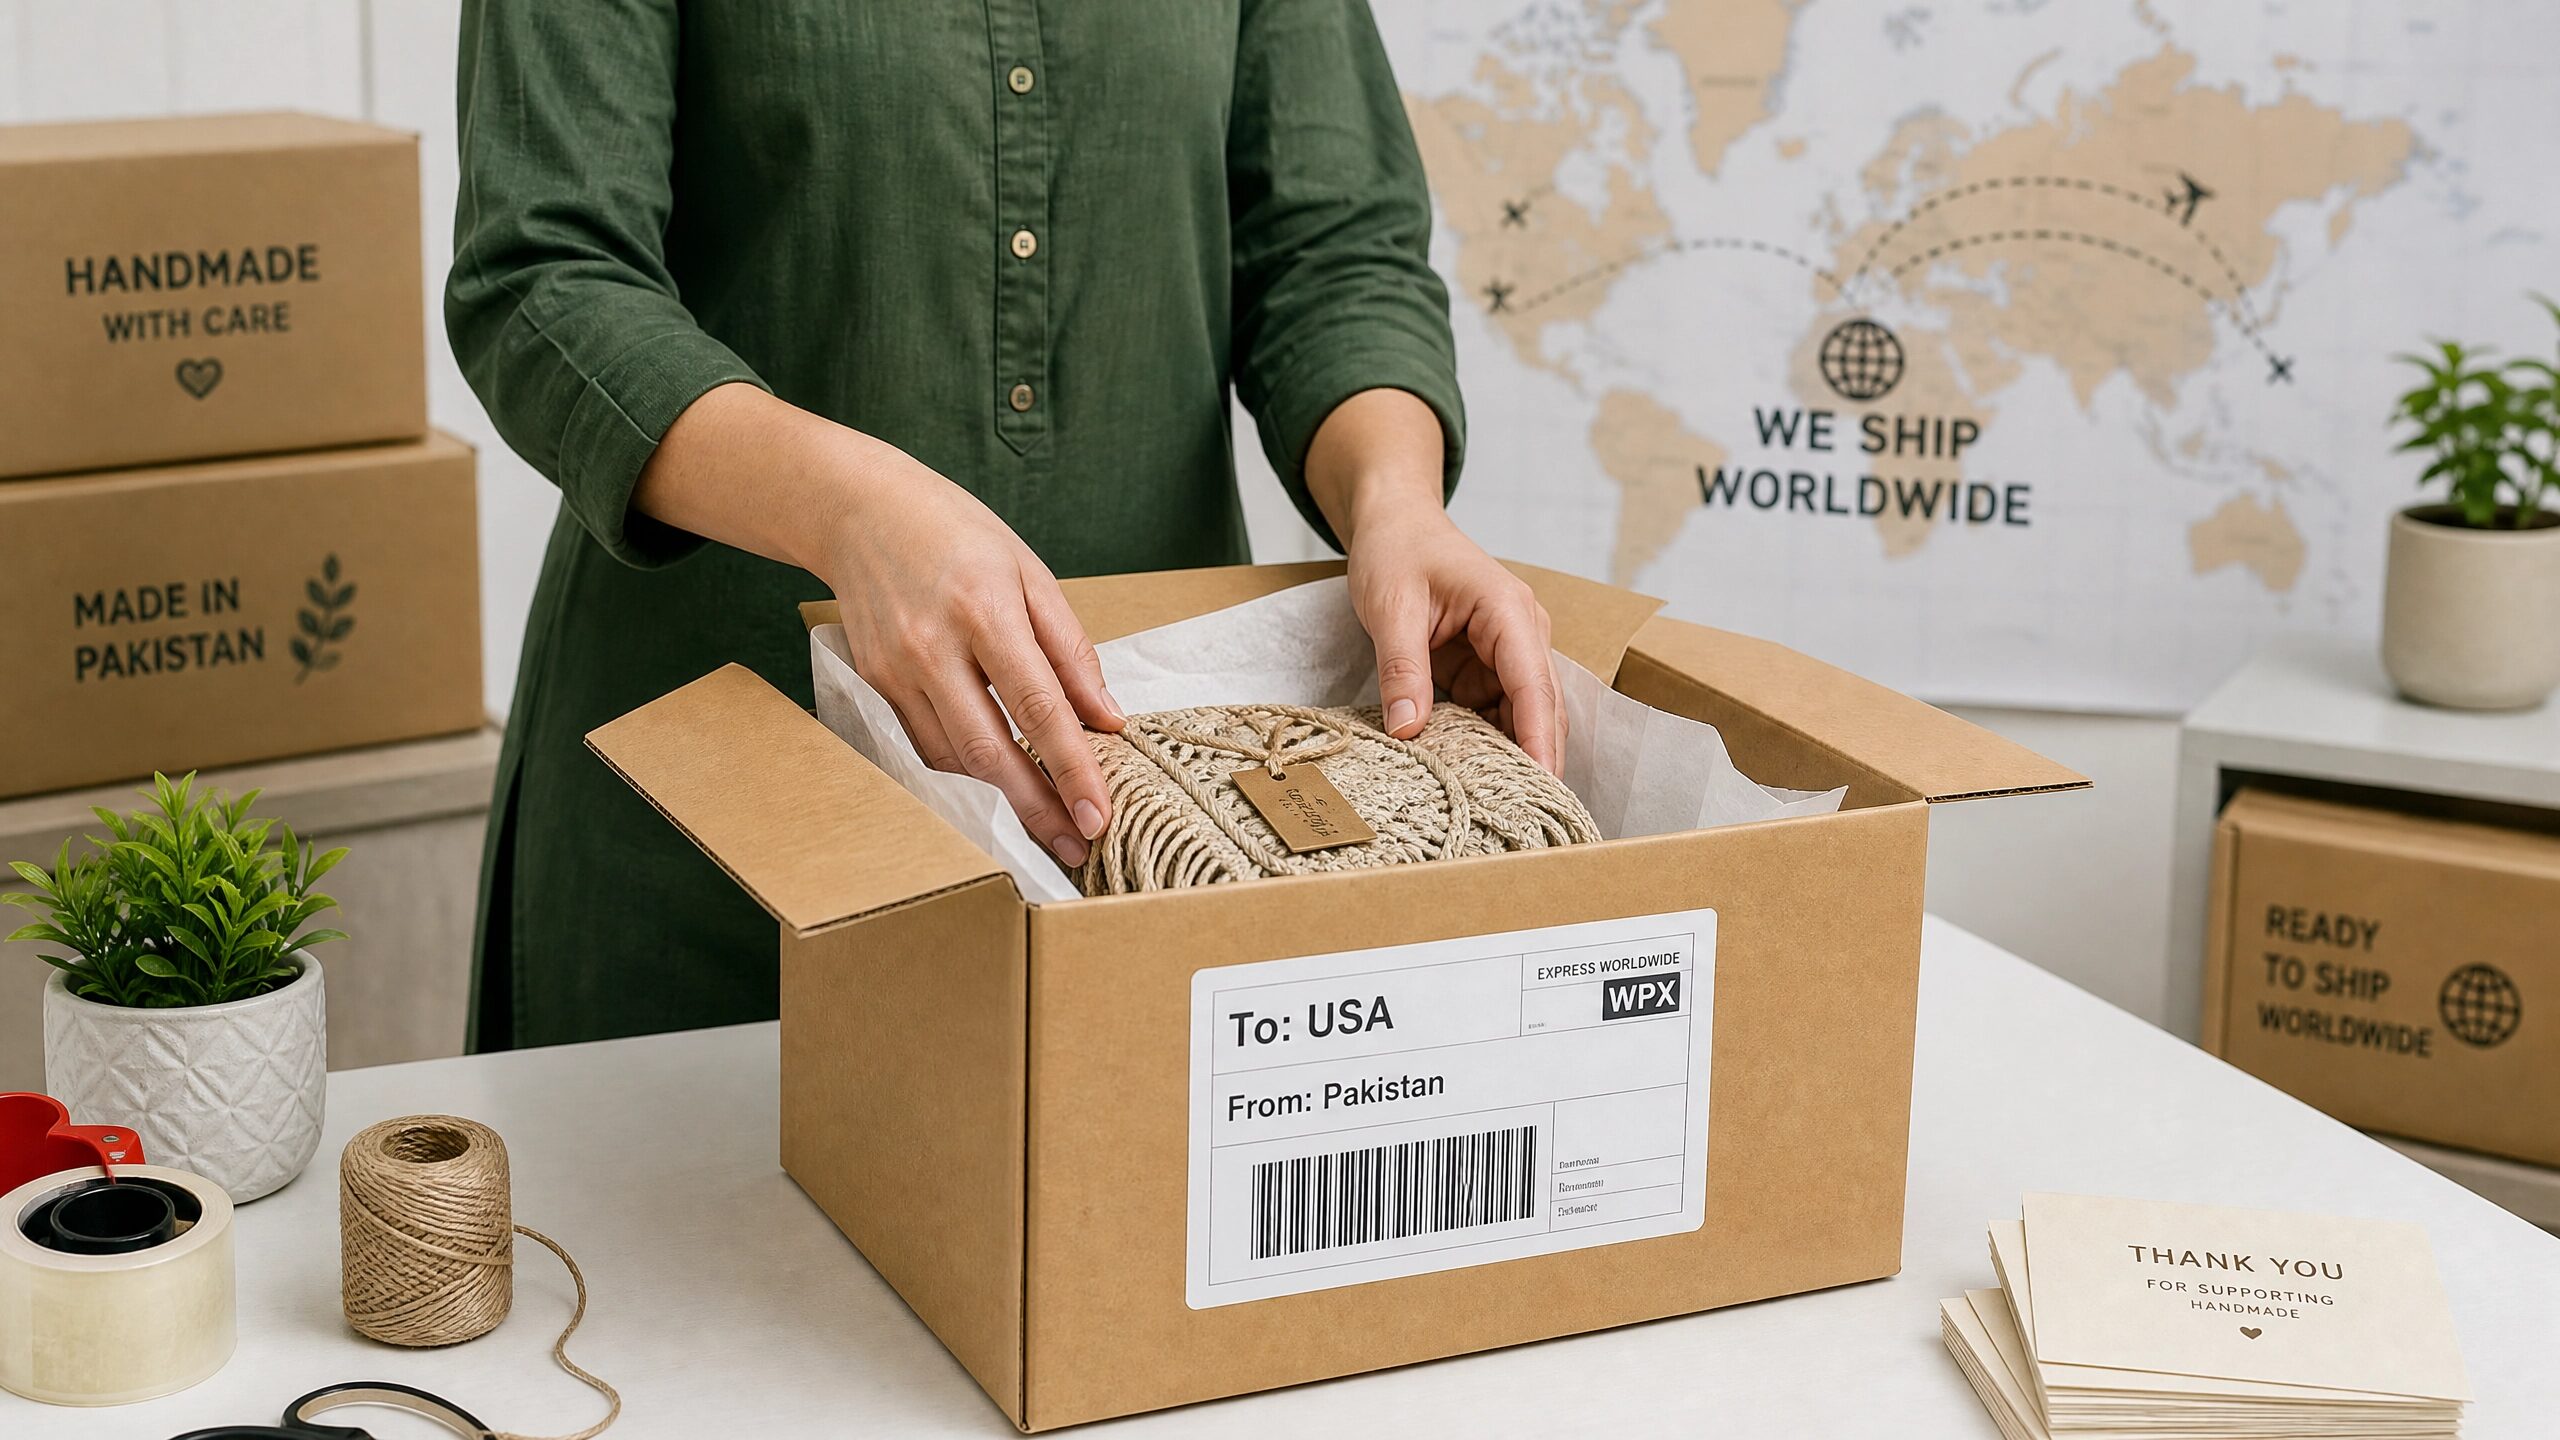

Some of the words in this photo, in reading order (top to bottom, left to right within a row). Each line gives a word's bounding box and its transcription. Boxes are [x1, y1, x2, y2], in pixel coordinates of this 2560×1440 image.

[66, 246, 319, 295] HANDMADE
[103, 310, 191, 342] WITH
[202, 302, 290, 336] CARE
[1755, 408, 1835, 451] WE
[1860, 413, 1980, 460] SHIP
[1695, 465, 2031, 526] WORLDWIDE
[74, 583, 188, 628] MADE
[202, 578, 240, 614] IN
[74, 629, 265, 683] PAKISTAN
[2264, 905, 2380, 952] READY
[1537, 962, 1596, 980] EXPRESS
[1600, 951, 1681, 973] WORLDWIDE
[2264, 952, 2305, 990] TO
[2314, 961, 2391, 1003] SHIP
[1608, 979, 1677, 1013] WPX
[1228, 1010, 1291, 1048] To:
[1308, 996, 1395, 1038] USA
[2257, 1003, 2434, 1058] WORLDWIDE
[1227, 1091, 1312, 1122] From:
[1323, 1072, 1445, 1110] Pakistan
[2128, 1245, 2256, 1273] THANK
[2269, 1256, 2345, 1281] YOU
[2147, 1279, 2188, 1293] FOR
[2198, 1283, 2335, 1306] SUPPORTING
[2191, 1299, 2301, 1320] HANDMADE
